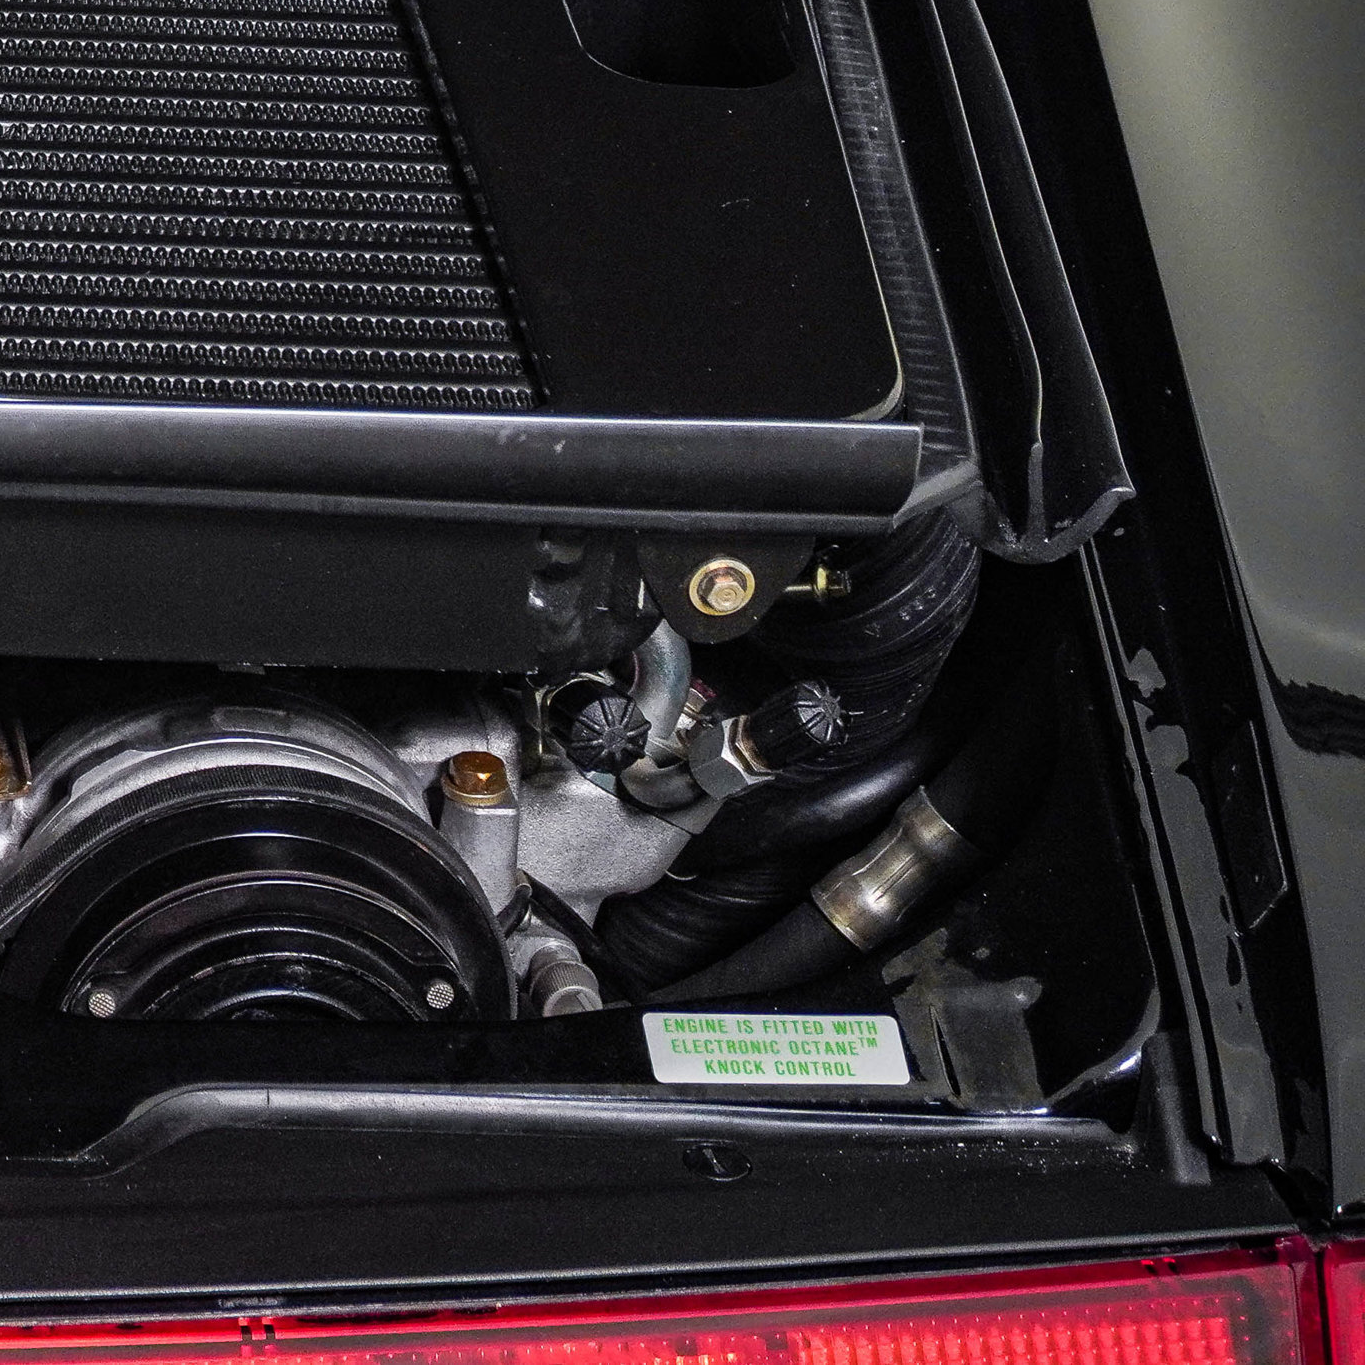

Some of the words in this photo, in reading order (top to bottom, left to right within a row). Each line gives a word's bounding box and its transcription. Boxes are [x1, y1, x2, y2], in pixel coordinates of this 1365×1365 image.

[663, 1017, 729, 1035] ENGINE
[736, 1019, 754, 1035] IS
[761, 1019, 824, 1036] FITTED
[831, 1020, 878, 1036] WITH
[670, 1038, 781, 1056] ELECTRONIC
[704, 1059, 766, 1075] KNOCK
[774, 1059, 857, 1077] CONTROL
